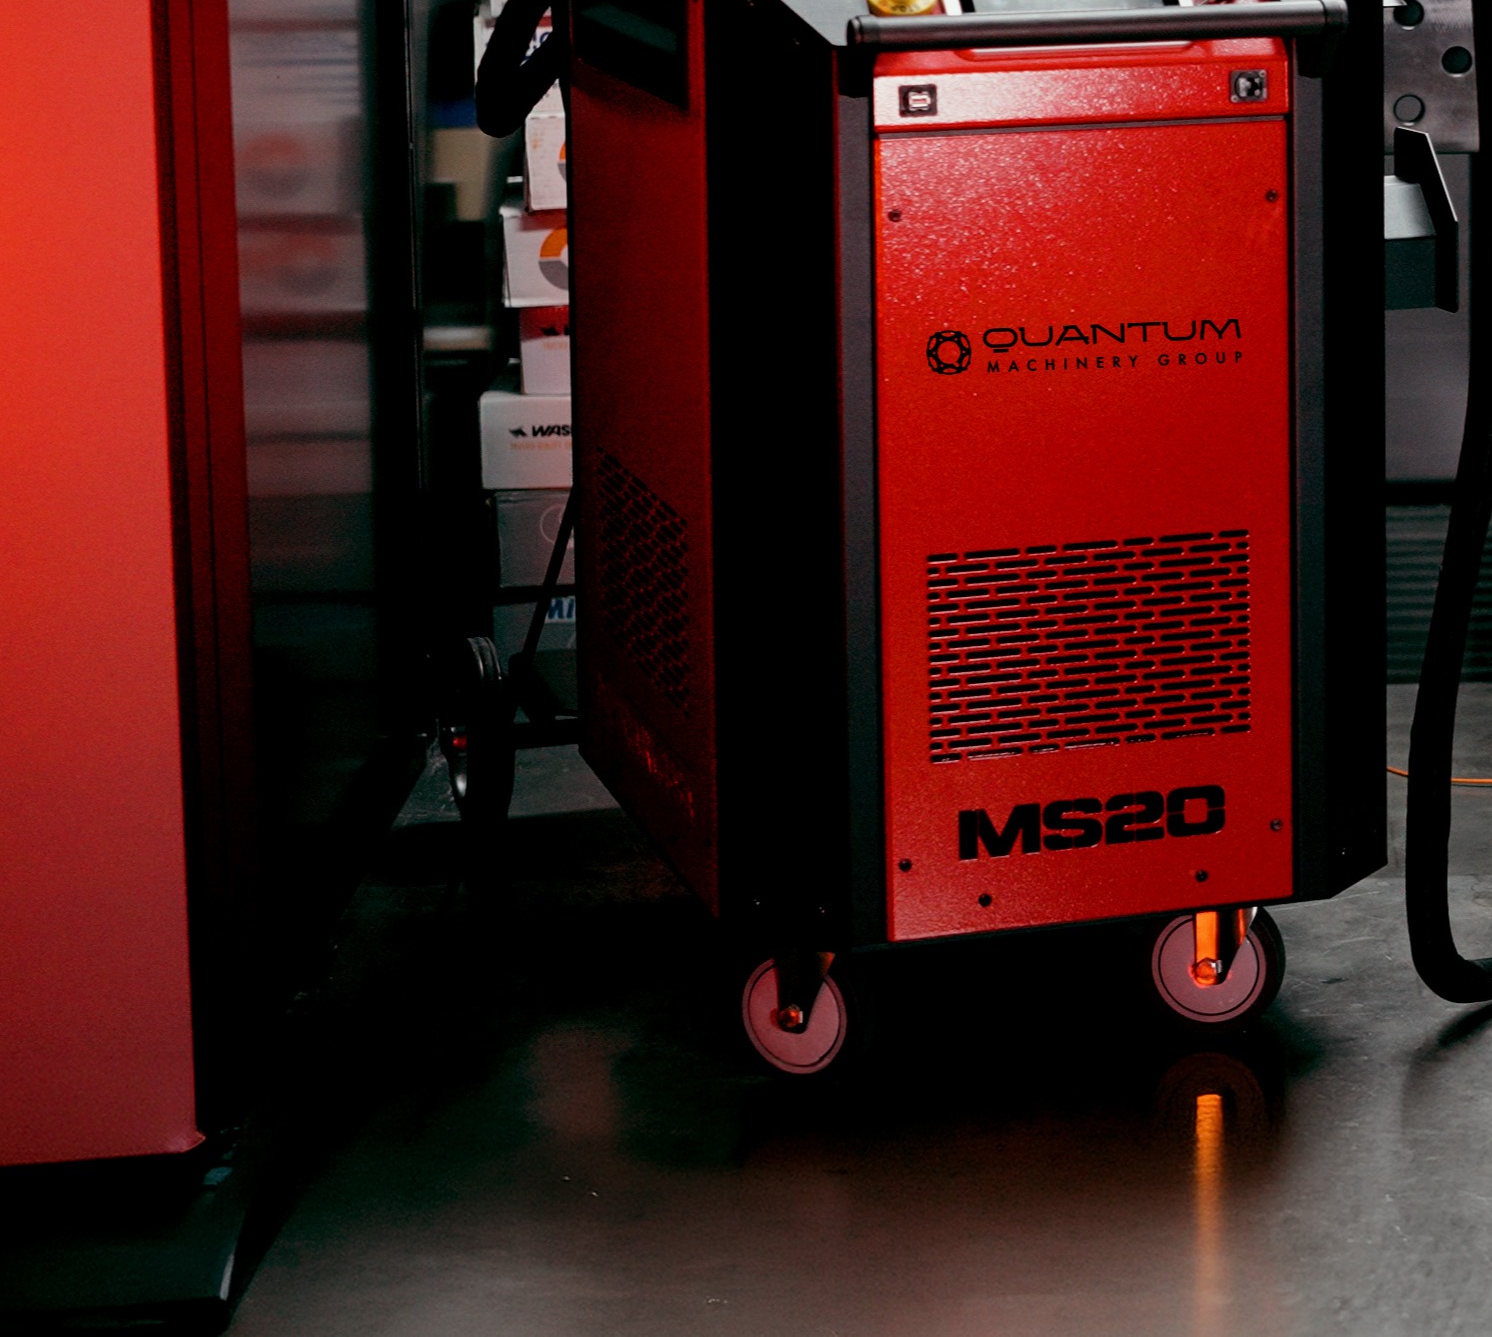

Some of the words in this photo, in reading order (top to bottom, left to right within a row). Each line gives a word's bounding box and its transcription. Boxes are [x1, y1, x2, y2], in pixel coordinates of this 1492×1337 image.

[982, 318, 1242, 353] QUANTUM
[987, 355, 1138, 373] MACHINERY
[1157, 351, 1243, 366] GROUP
[958, 784, 1226, 861] MS20
